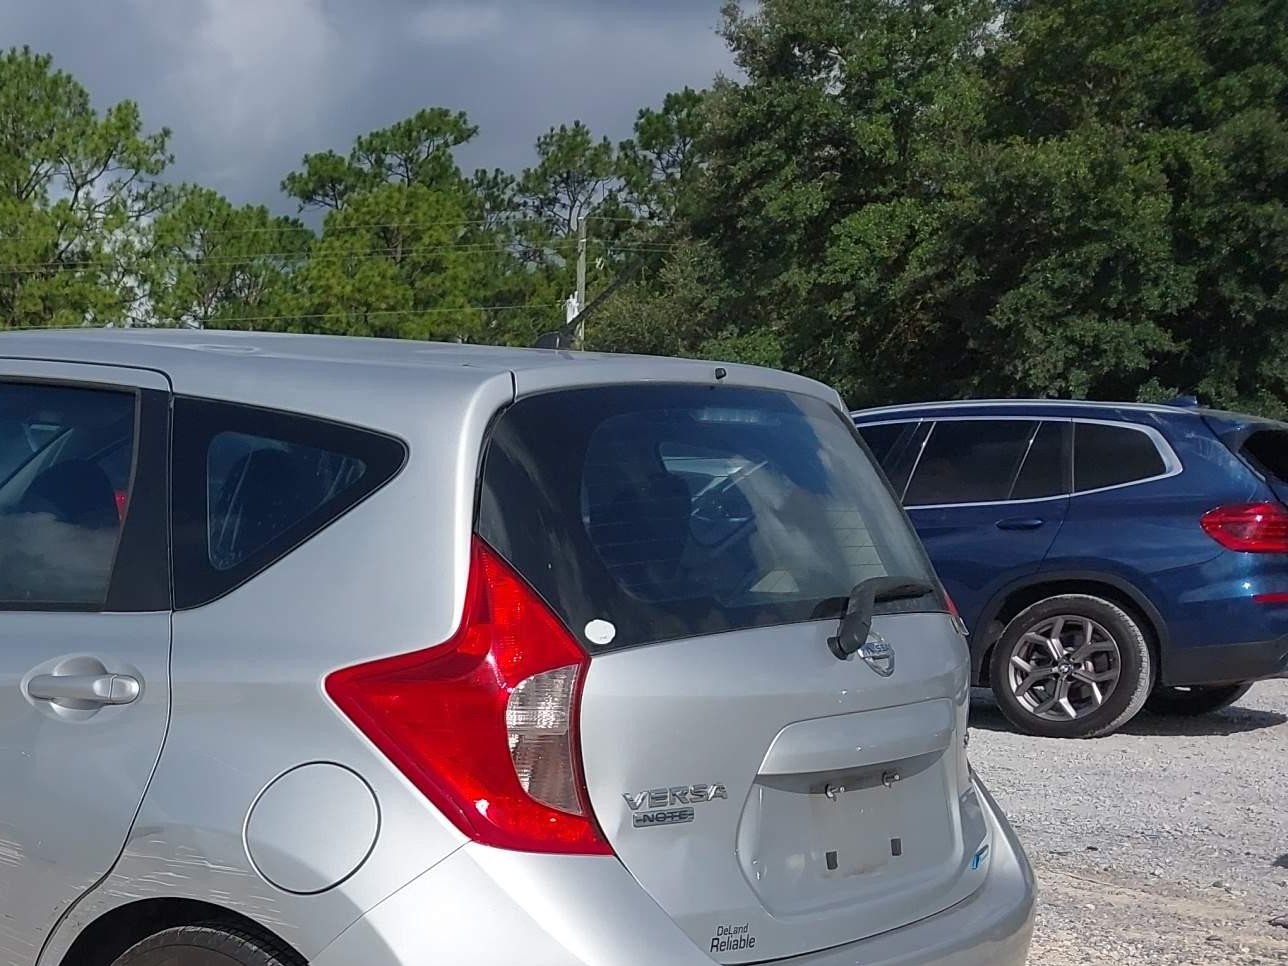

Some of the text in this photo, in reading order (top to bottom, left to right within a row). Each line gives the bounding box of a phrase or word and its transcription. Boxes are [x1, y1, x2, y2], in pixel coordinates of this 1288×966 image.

[622, 784, 728, 810] VERSA
[641, 809, 690, 823] NOTE
[717, 922, 749, 936] DeLand
[710, 934, 756, 952] Reliable
